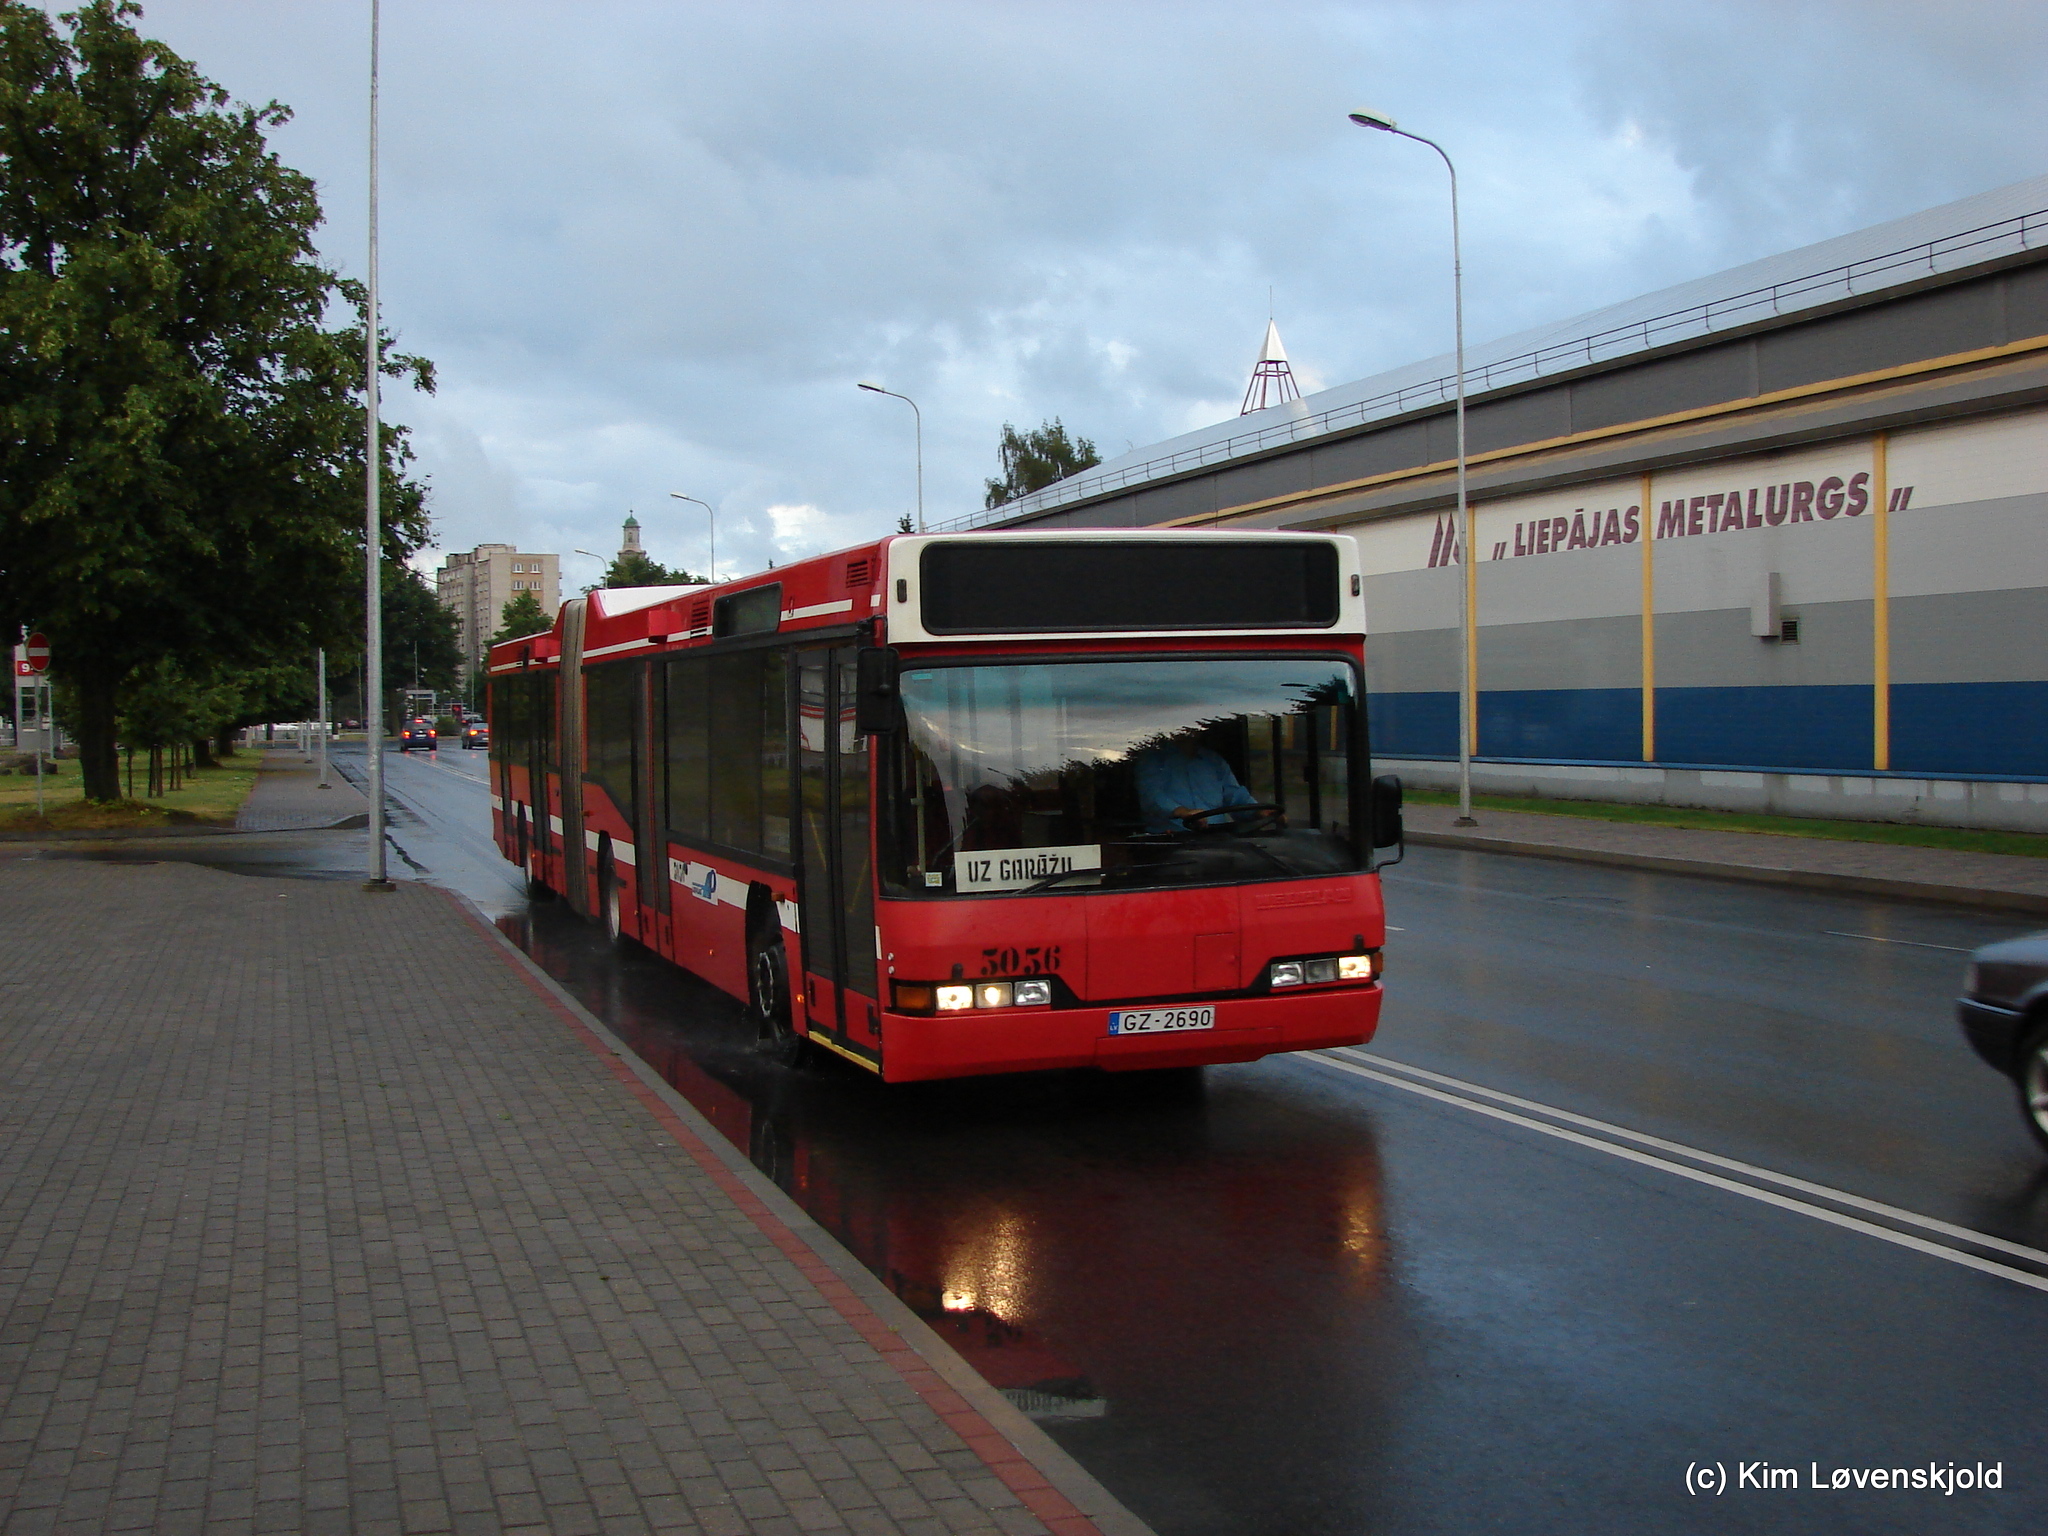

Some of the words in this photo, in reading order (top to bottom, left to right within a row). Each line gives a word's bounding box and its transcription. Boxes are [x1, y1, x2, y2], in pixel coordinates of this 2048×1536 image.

[967, 860, 992, 883] UZ
[1000, 854, 1072, 881] GARĀŽU
[981, 944, 1060, 975] 5056
[1124, 1010, 1211, 1031] GZ-2690
